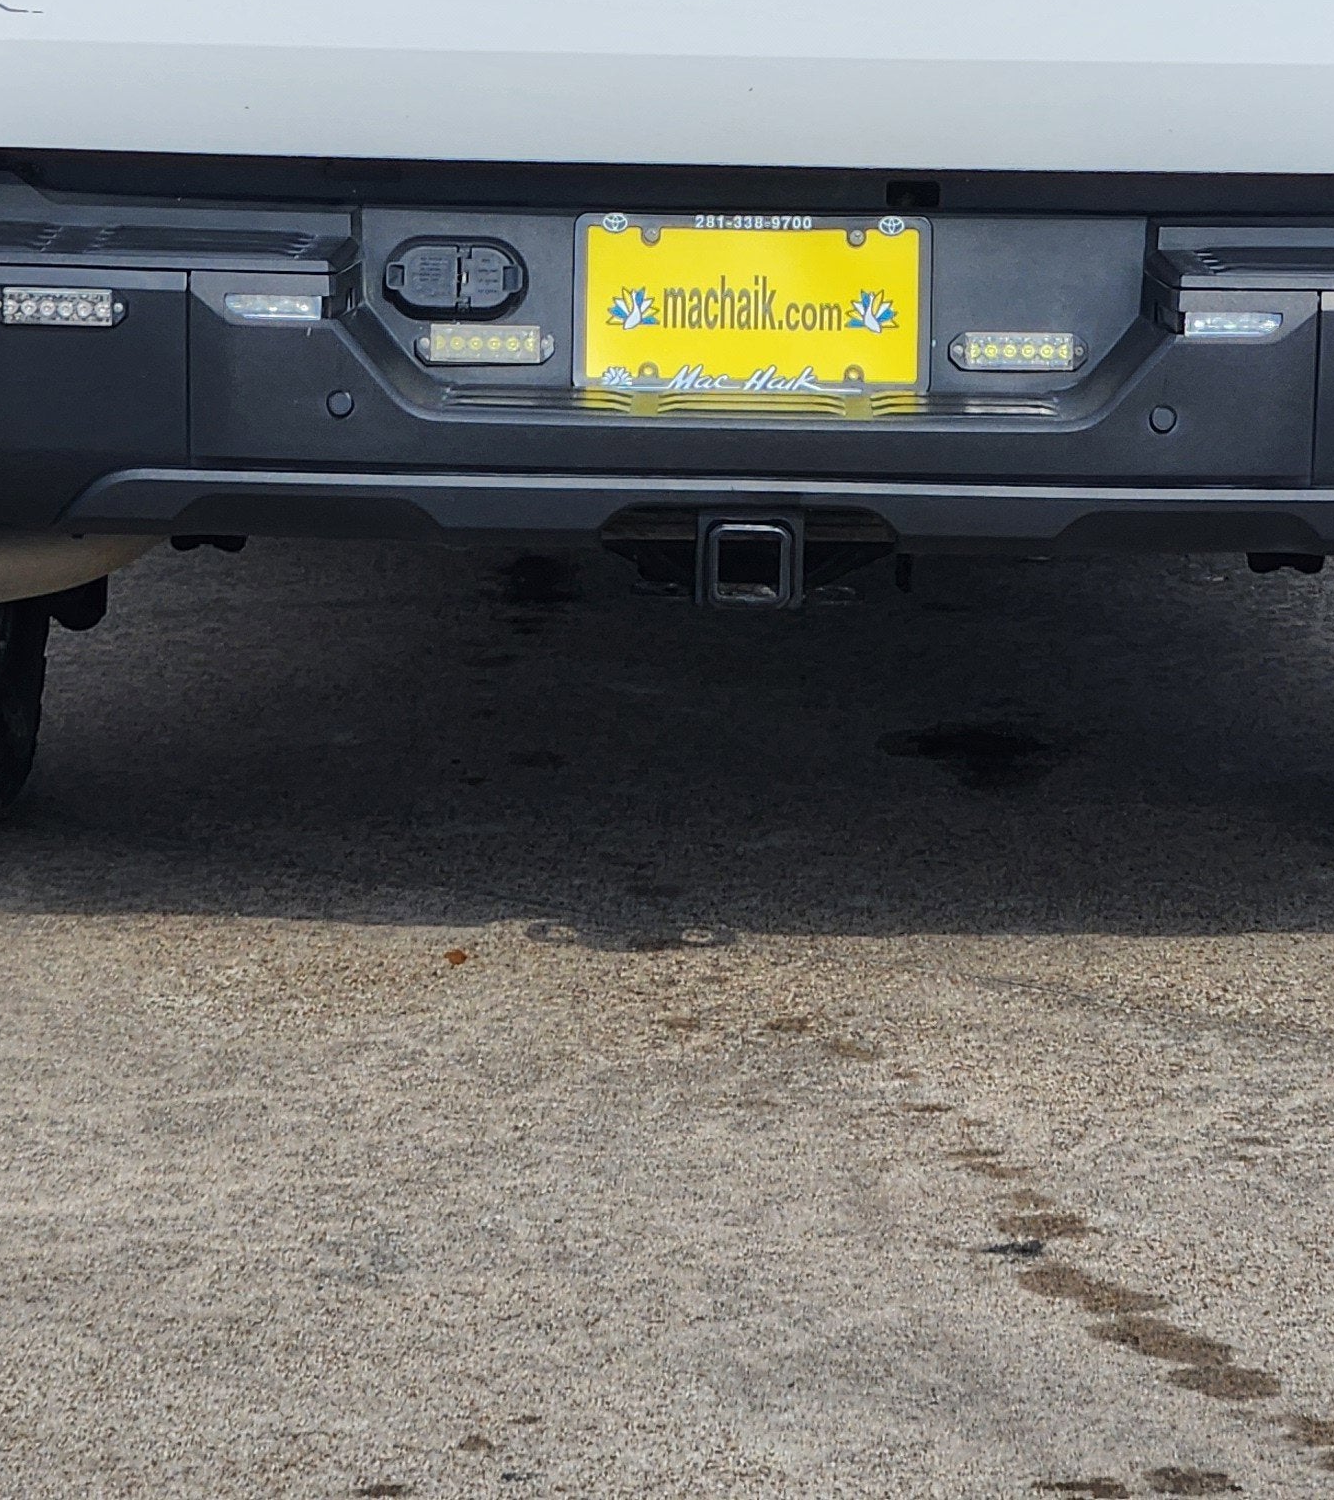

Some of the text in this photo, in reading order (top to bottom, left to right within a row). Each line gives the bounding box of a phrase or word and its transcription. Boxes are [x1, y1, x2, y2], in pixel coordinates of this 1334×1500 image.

[695, 215, 813, 230] 281-338-9700
[663, 275, 843, 331] machaik.com
[667, 364, 827, 392] Mac Haik
